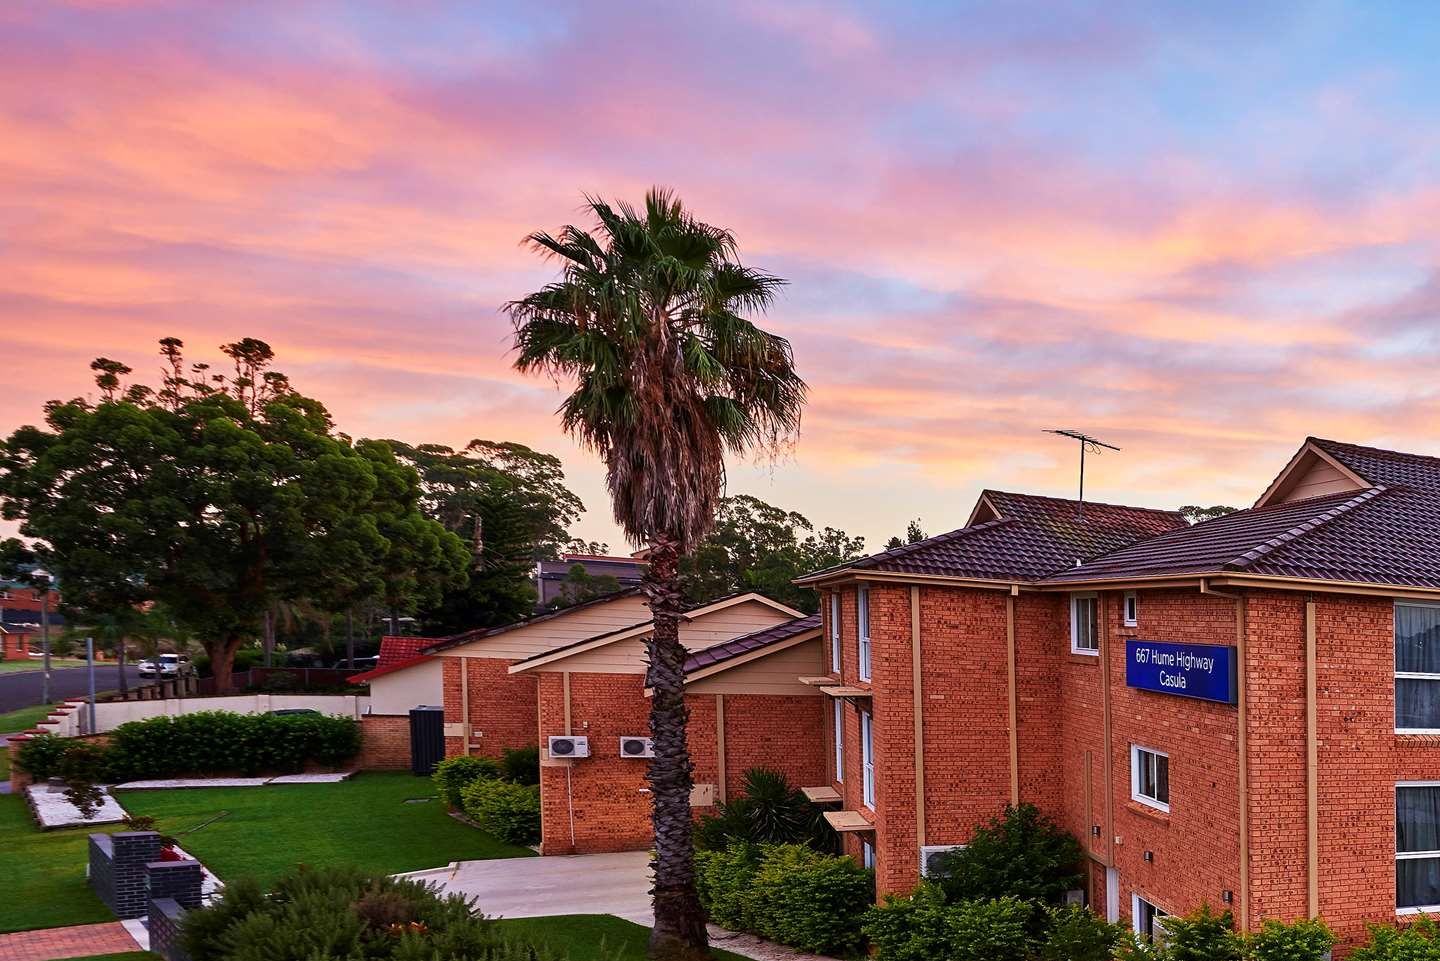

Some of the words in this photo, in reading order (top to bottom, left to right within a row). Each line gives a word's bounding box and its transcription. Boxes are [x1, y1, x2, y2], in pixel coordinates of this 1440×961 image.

[1135, 648, 1150, 663] 667
[1151, 649, 1174, 666] Hume
[1176, 651, 1214, 673] Highway
[1159, 670, 1187, 689] Casula
